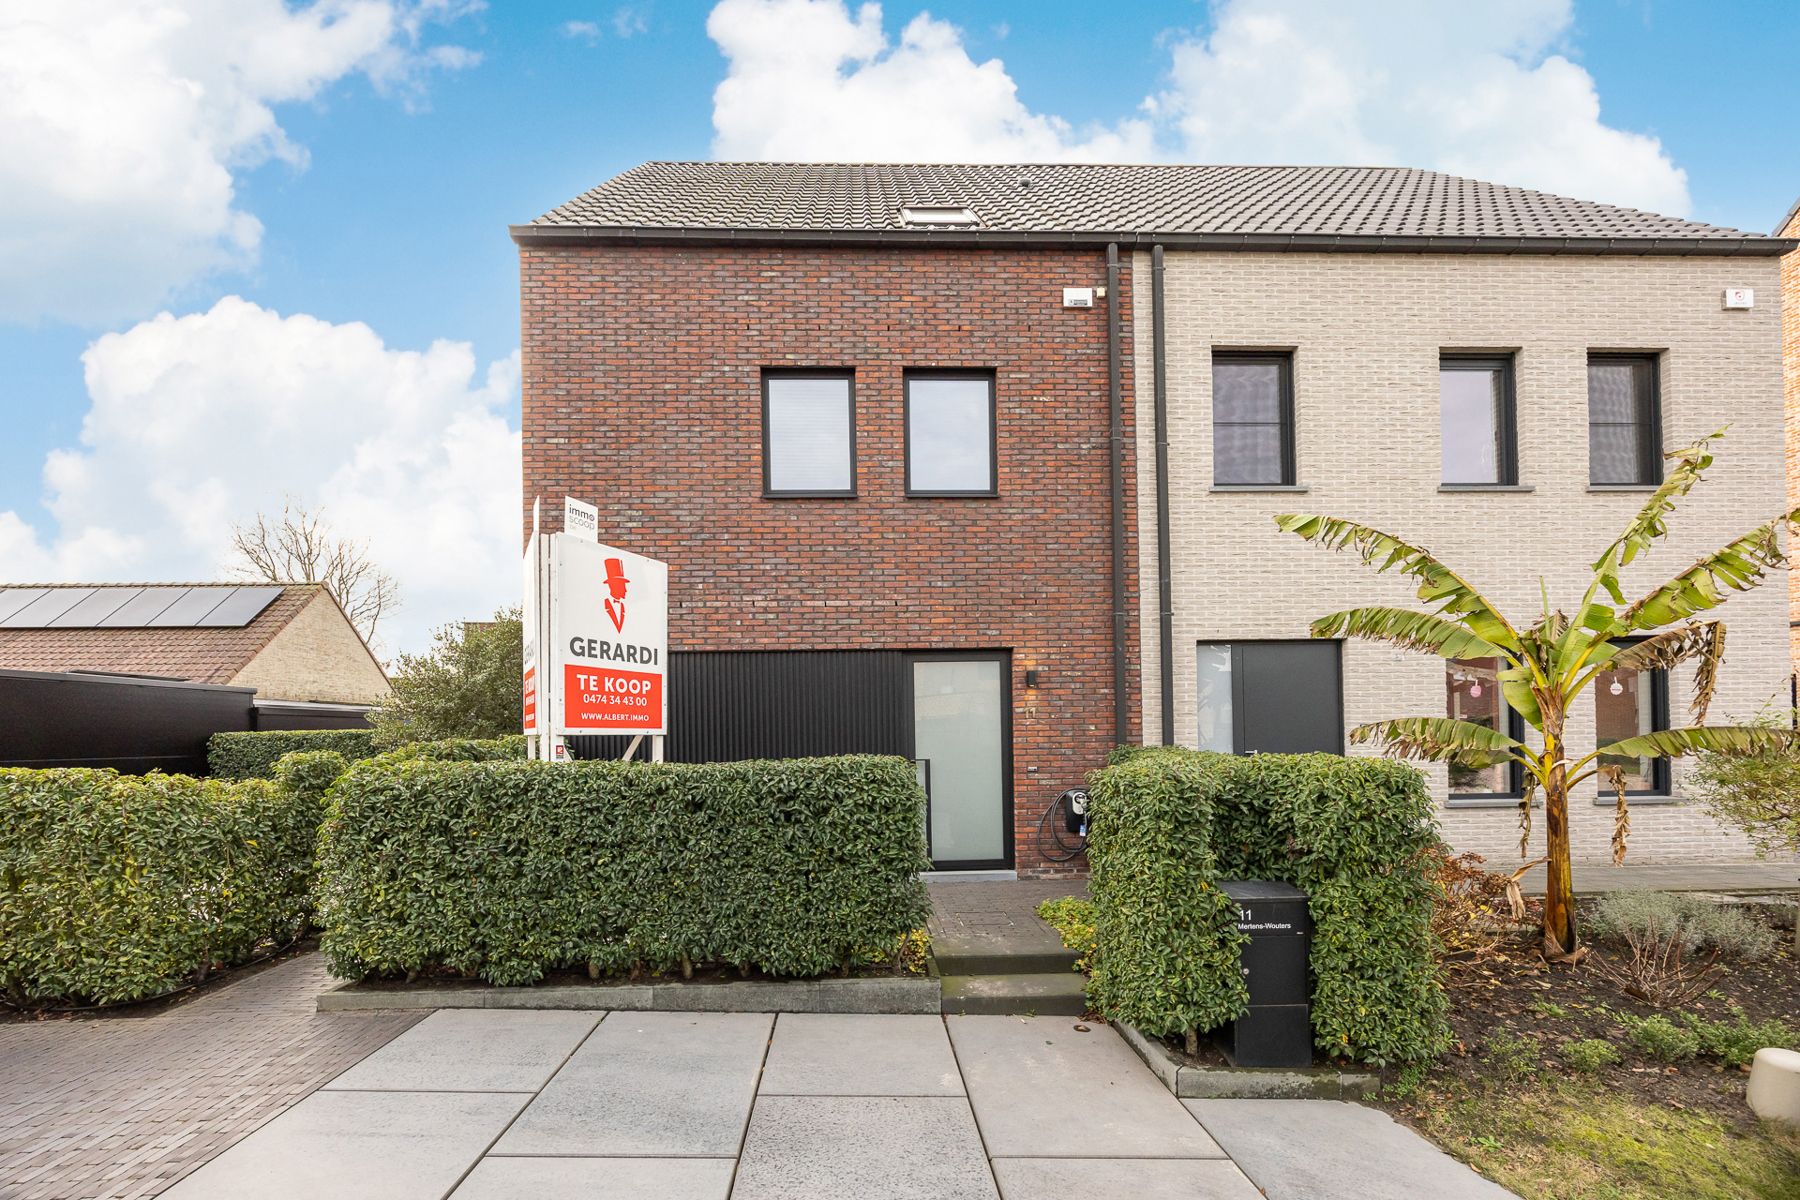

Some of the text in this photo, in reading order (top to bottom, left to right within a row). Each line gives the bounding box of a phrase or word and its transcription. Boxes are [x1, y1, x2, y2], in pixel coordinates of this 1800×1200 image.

[569, 503, 595, 521] immo
[569, 515, 595, 530] scoop
[569, 636, 658, 666] GERARDI
[576, 673, 651, 695] TE KOOP
[583, 693, 647, 707] 0474 34 43 00
[581, 712, 650, 722] WWW.ALBERT.IMMO
[1240, 909, 1252, 921] 11
[1237, 922, 1291, 930] Mertens-Wouters
